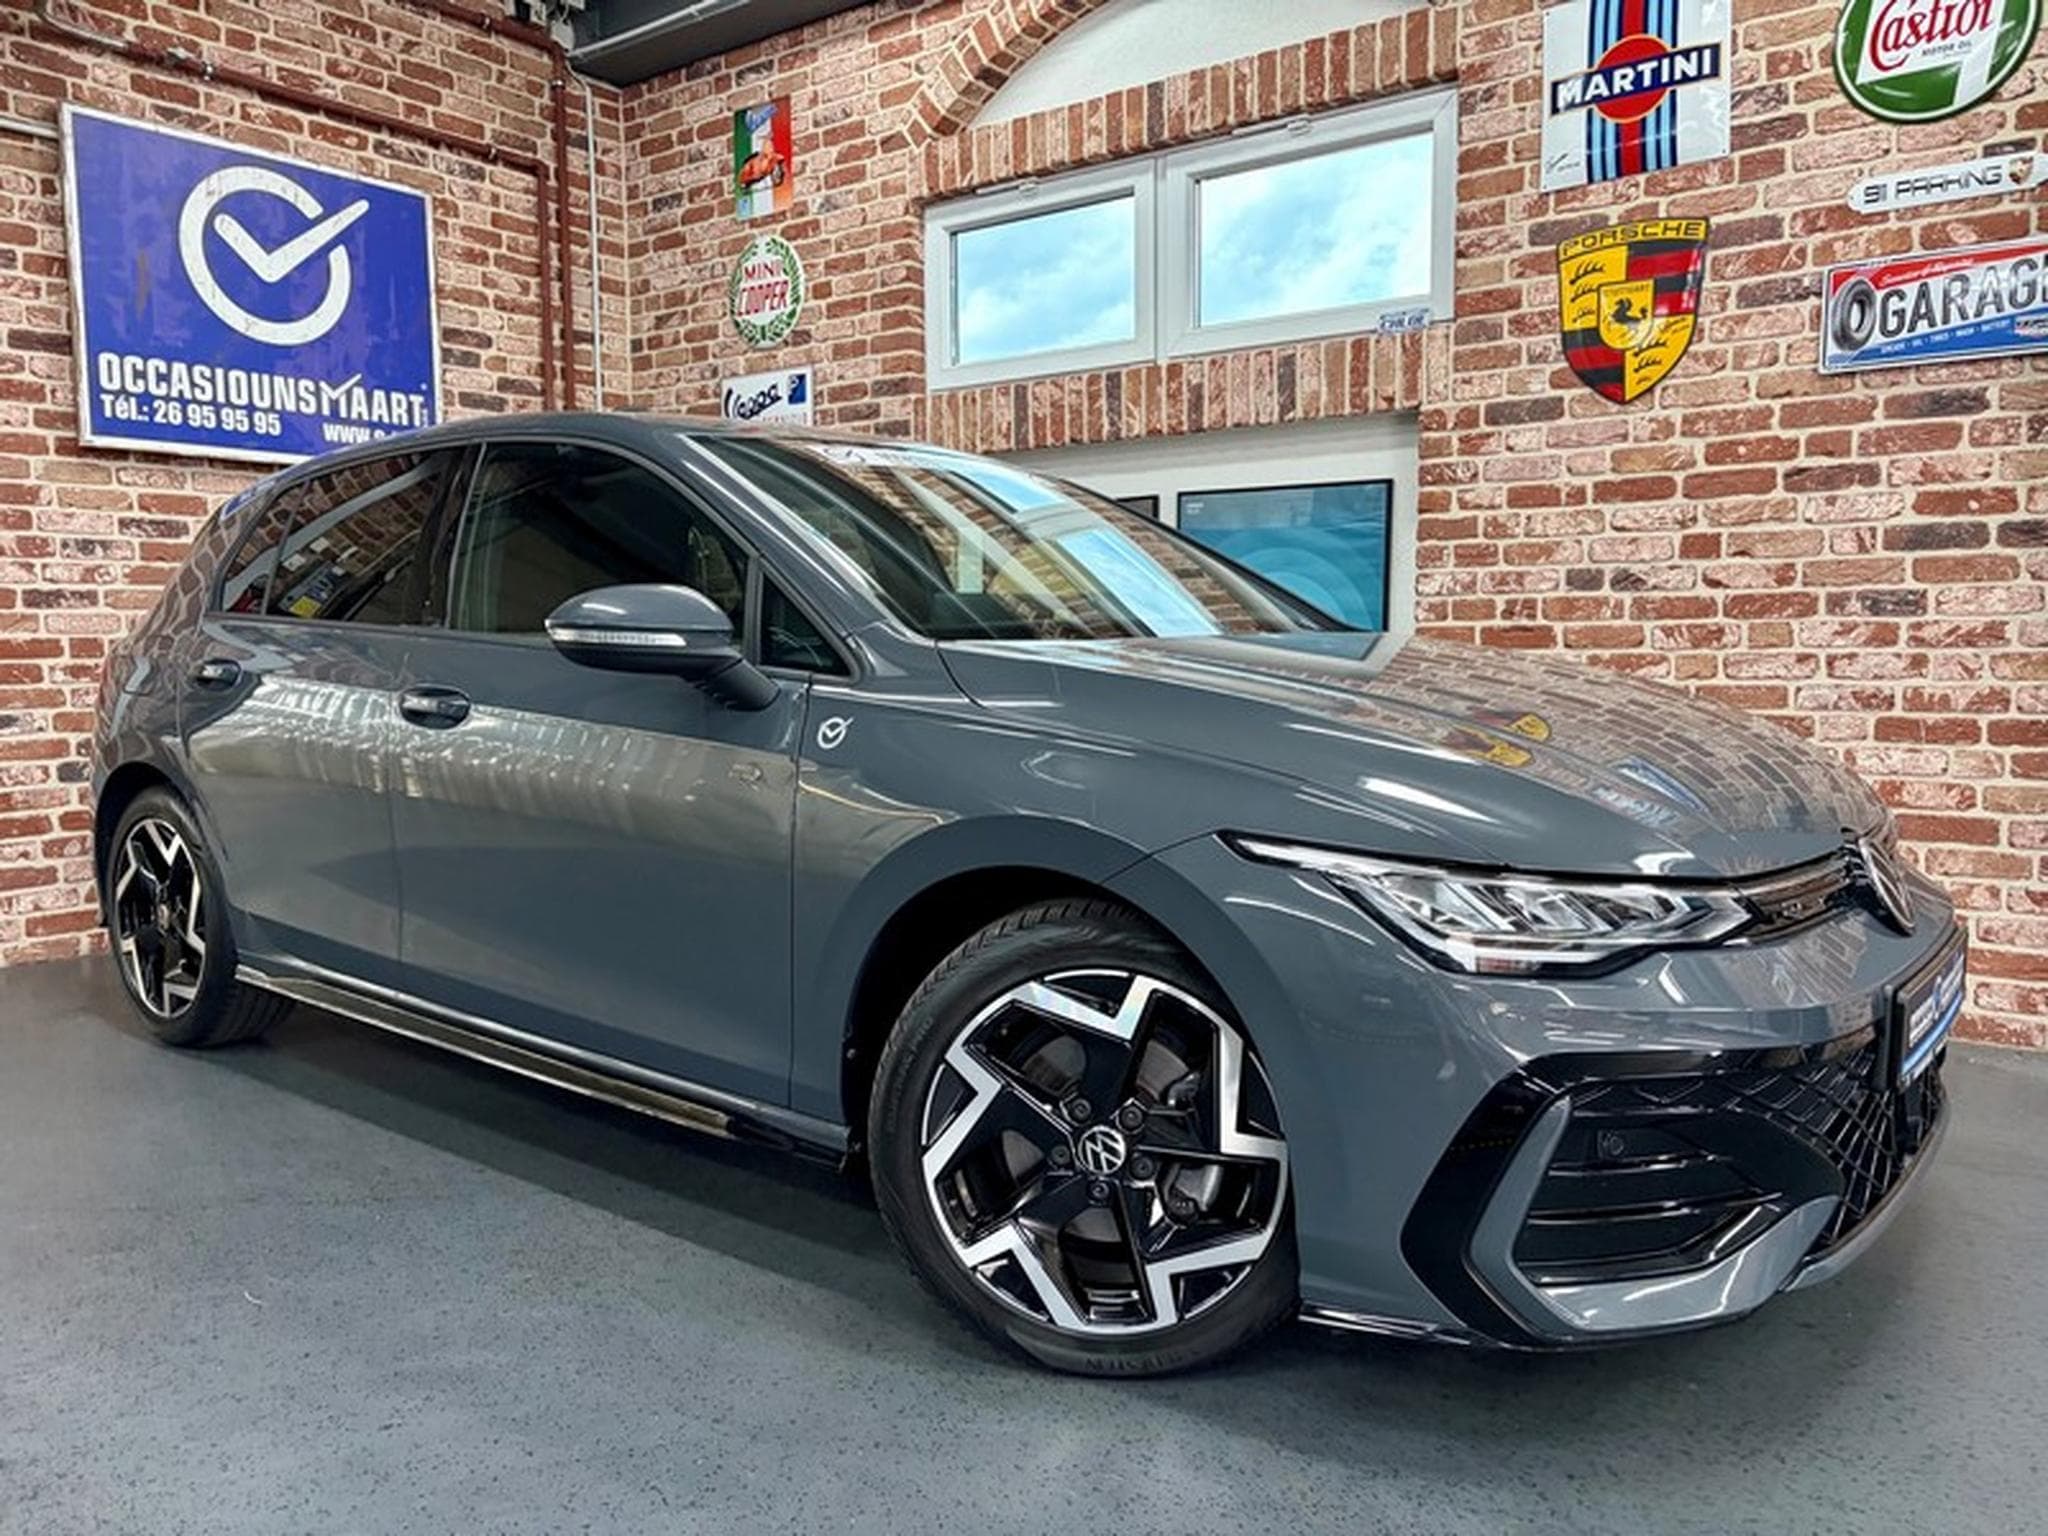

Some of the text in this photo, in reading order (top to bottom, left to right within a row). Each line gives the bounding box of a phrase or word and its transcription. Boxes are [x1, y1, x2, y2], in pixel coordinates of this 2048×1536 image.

[1557, 47, 1712, 112] MARTINI
[1894, 165, 2003, 199] PARKING
[1562, 221, 1702, 257] PORSCHE
[744, 261, 785, 279] MINI
[736, 280, 789, 316] COOPER
[1878, 252, 2048, 339] GARAG
[98, 352, 424, 428] OCCASIOUNSMAART
[153, 399, 183, 426] 26
[187, 403, 216, 429] 95
[221, 407, 250, 433] 95
[253, 411, 281, 437] 95
